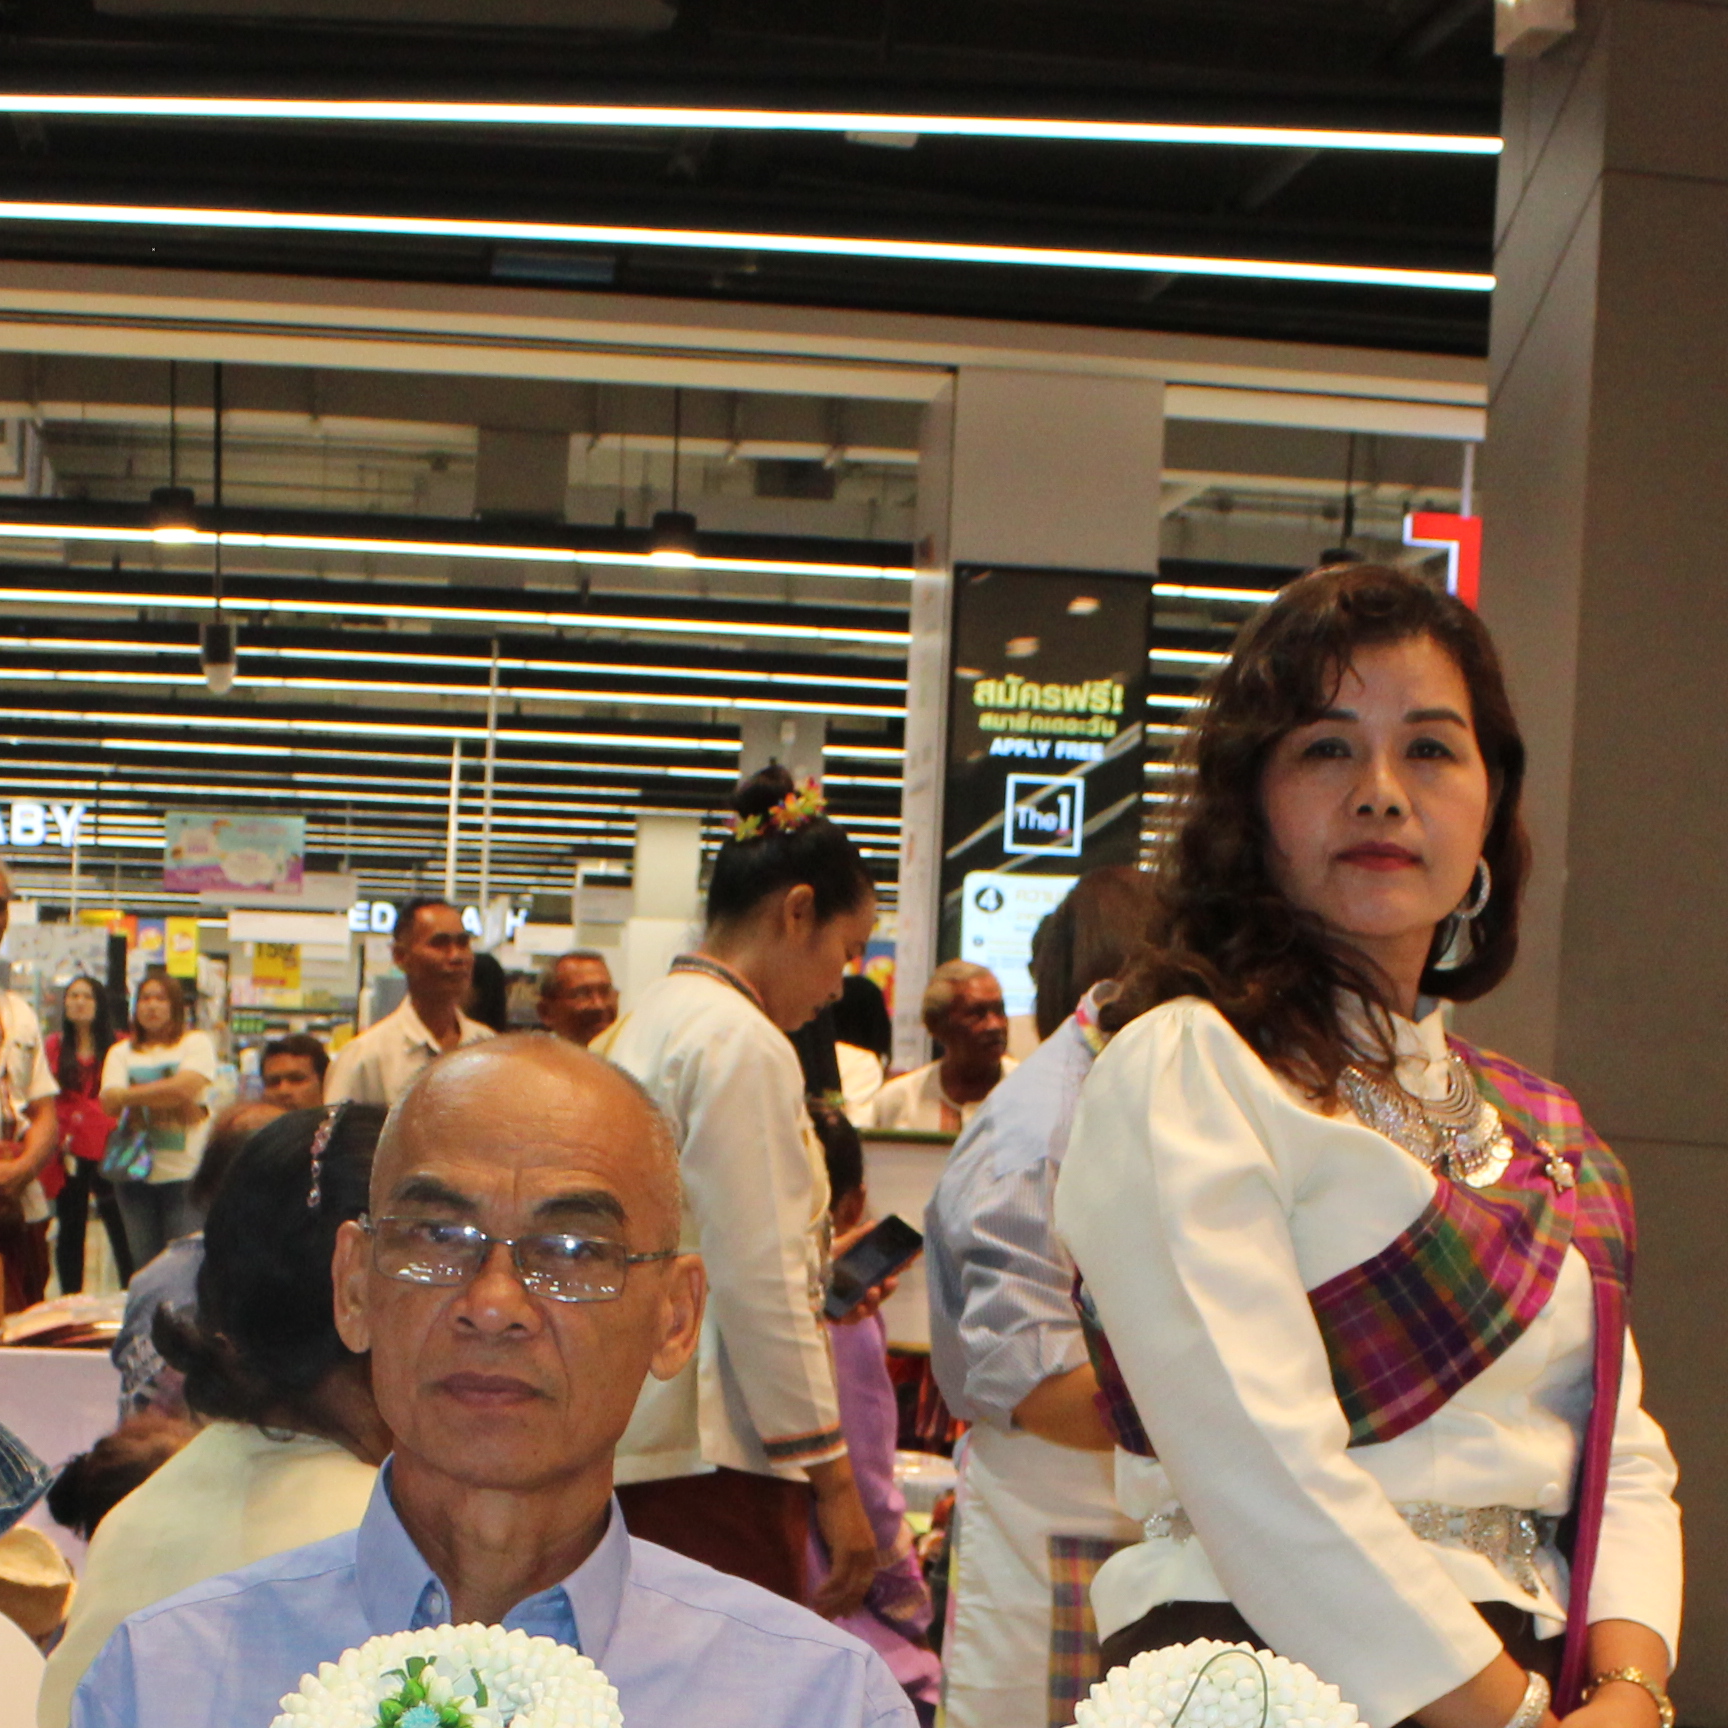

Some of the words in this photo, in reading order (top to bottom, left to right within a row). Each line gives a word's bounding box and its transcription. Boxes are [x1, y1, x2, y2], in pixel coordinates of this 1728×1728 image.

[974, 673, 1125, 715] สมัครฟรี!
[989, 736, 1051, 759] APPLY
[1054, 739, 1105, 762] FREE
